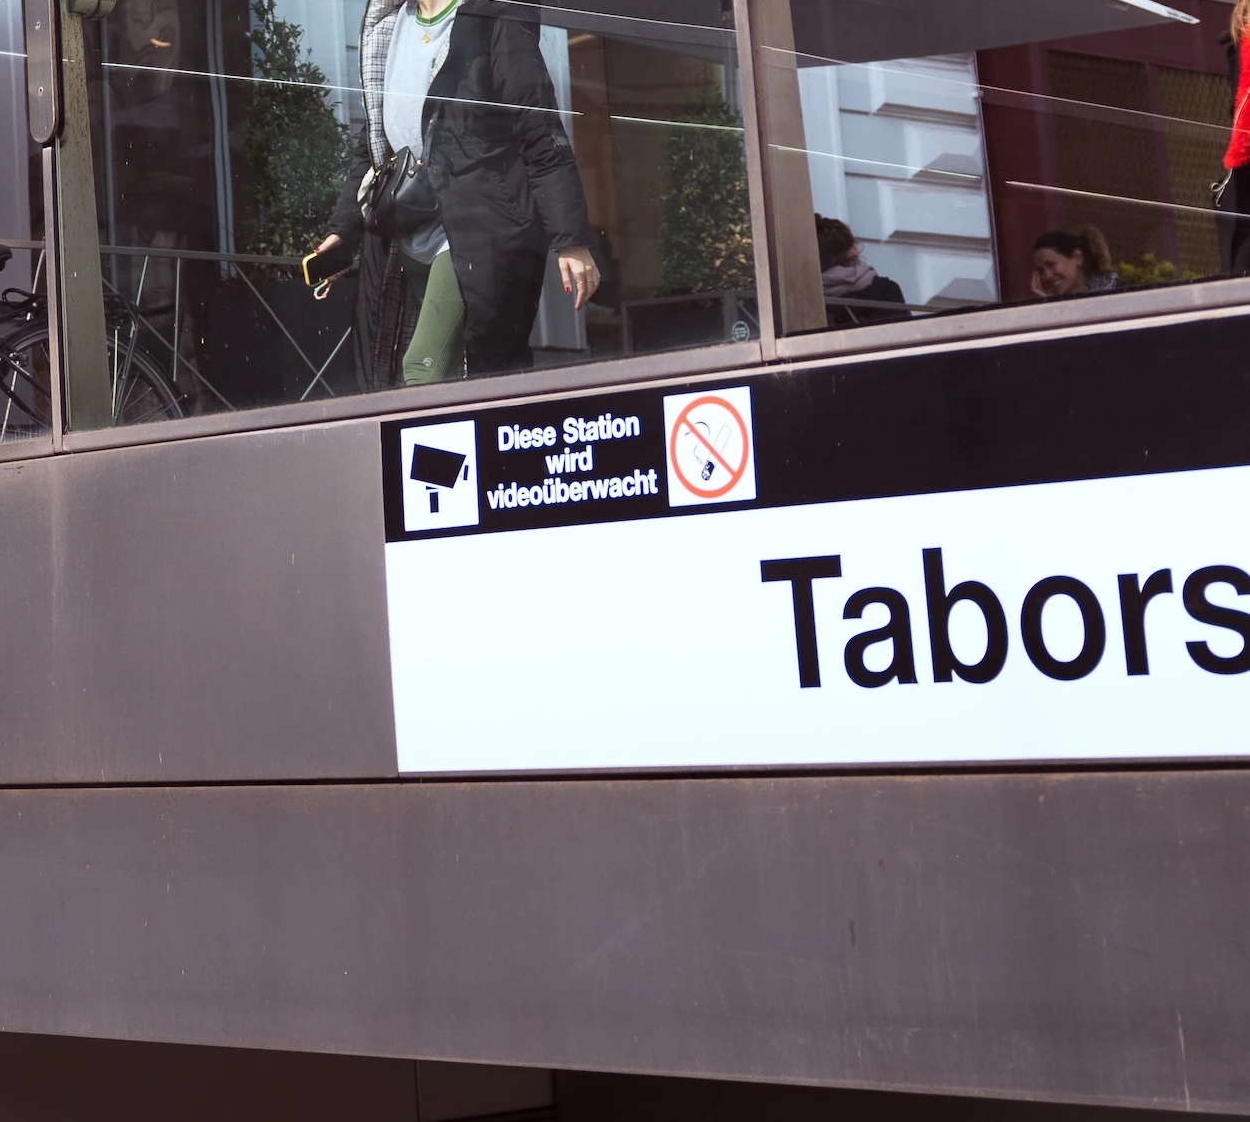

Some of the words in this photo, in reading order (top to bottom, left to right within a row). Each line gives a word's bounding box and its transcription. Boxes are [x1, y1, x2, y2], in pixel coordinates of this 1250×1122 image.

[498, 424, 557, 451] Diese
[562, 413, 640, 445] Station
[545, 445, 593, 475] wird
[487, 468, 658, 510] videoüberwacht
[760, 547, 1250, 689] Tabors
